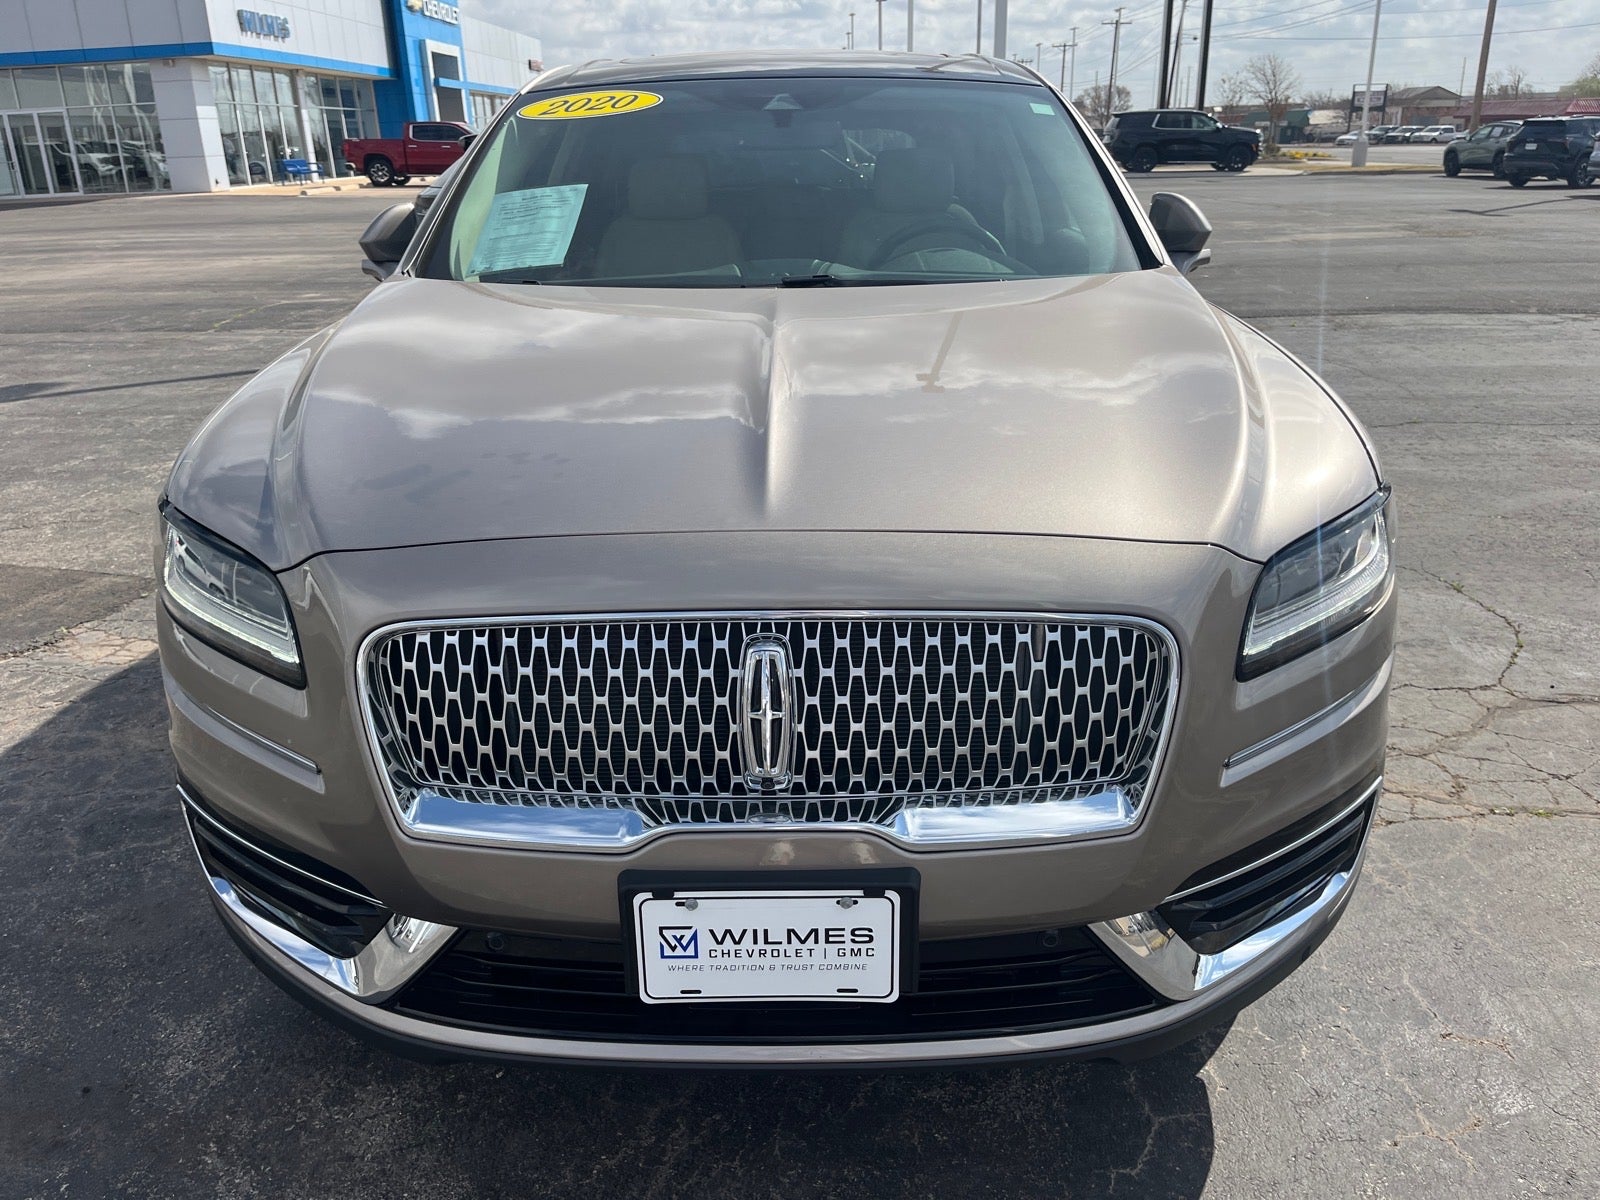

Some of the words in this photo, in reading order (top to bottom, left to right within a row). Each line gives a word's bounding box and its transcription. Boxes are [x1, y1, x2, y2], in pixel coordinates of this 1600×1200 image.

[538, 94, 639, 116] 2020
[708, 927, 875, 945] WILMES
[708, 948, 816, 958] CHEVROLET
[837, 947, 875, 957] GMC
[667, 964, 704, 972] WHERE
[710, 964, 765, 972] TRADITION
[781, 963, 815, 971] TRUST
[818, 963, 868, 971] COMBINE
